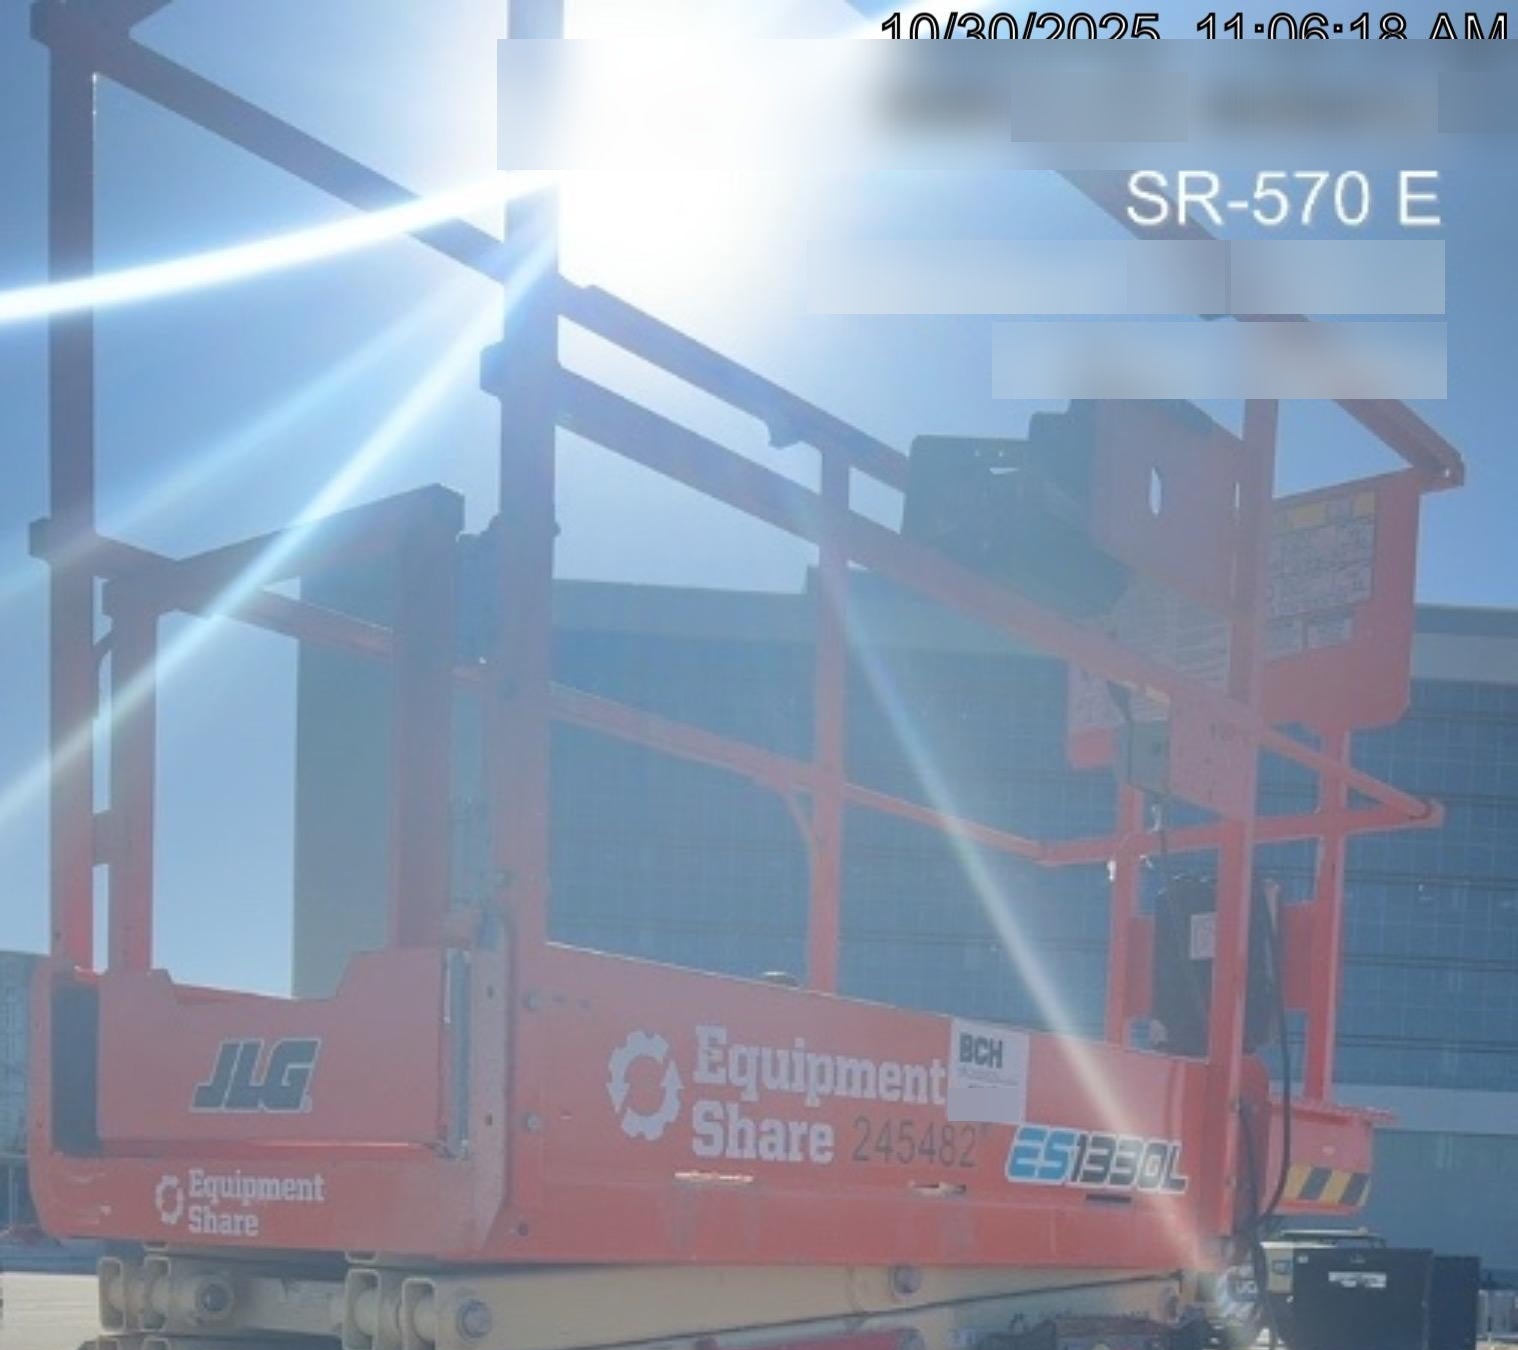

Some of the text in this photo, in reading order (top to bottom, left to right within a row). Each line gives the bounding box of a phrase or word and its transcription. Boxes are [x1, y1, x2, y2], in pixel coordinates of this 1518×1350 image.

[189, 1036, 321, 1114] JLG
[692, 1024, 948, 1108] Equipment
[959, 1032, 1003, 1069] BCH
[692, 1099, 835, 1164] Share
[852, 1114, 977, 1169] 245482
[1006, 1124, 1189, 1195] ES1330L
[188, 1169, 325, 1206] Equipment
[188, 1205, 259, 1237] Share
